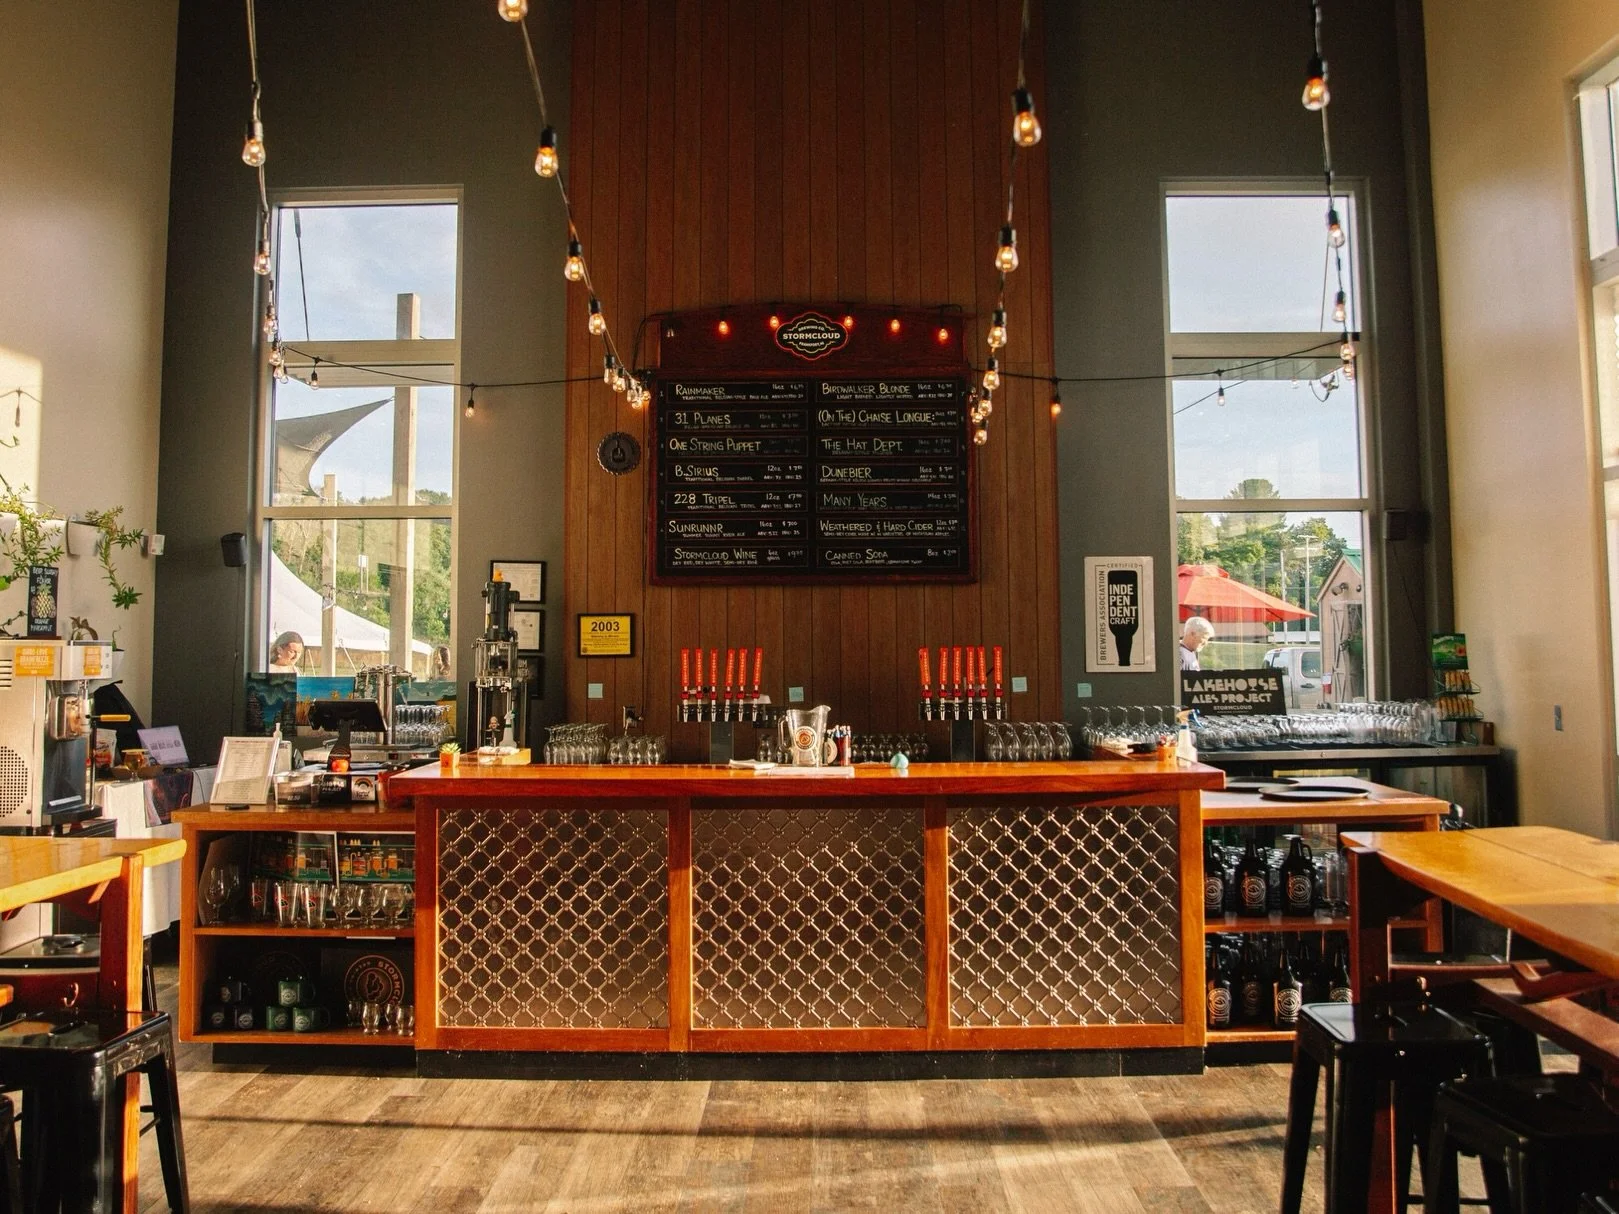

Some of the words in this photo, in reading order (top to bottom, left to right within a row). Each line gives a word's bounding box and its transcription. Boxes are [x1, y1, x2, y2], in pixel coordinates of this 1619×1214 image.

[676, 384, 725, 396] RAINMAKER
[880, 383, 910, 395] BLONDE
[675, 413, 688, 425] 31
[694, 412, 731, 425] PLANES
[670, 438, 688, 451] ONE
[690, 438, 724, 451] STRING
[726, 438, 762, 451] PUPPET
[821, 439, 841, 451] THE
[847, 438, 868, 450] HAT
[822, 466, 872, 479] DUNEBIER
[674, 493, 697, 504] 228
[702, 493, 736, 505] TRIPEL
[824, 494, 852, 506] MANY
[857, 493, 887, 508] YEARS
[669, 520, 724, 533] SUNRUNNR
[883, 521, 907, 532] HARD
[908, 520, 934, 531] CIDER
[675, 548, 729, 560] STORMCLOUD
[733, 548, 758, 560] WINE
[825, 550, 862, 561] CANNED
[1098, 570, 1107, 621] ASSOCIATION
[1109, 584, 1134, 595] INDE
[1109, 596, 1130, 606] PEN
[1110, 606, 1138, 617] DENT
[592, 622, 620, 632] 2003
[1110, 617, 1136, 625] CRAFT
[1192, 694, 1219, 704] ALES
[1221, 693, 1272, 703] PROJECT
